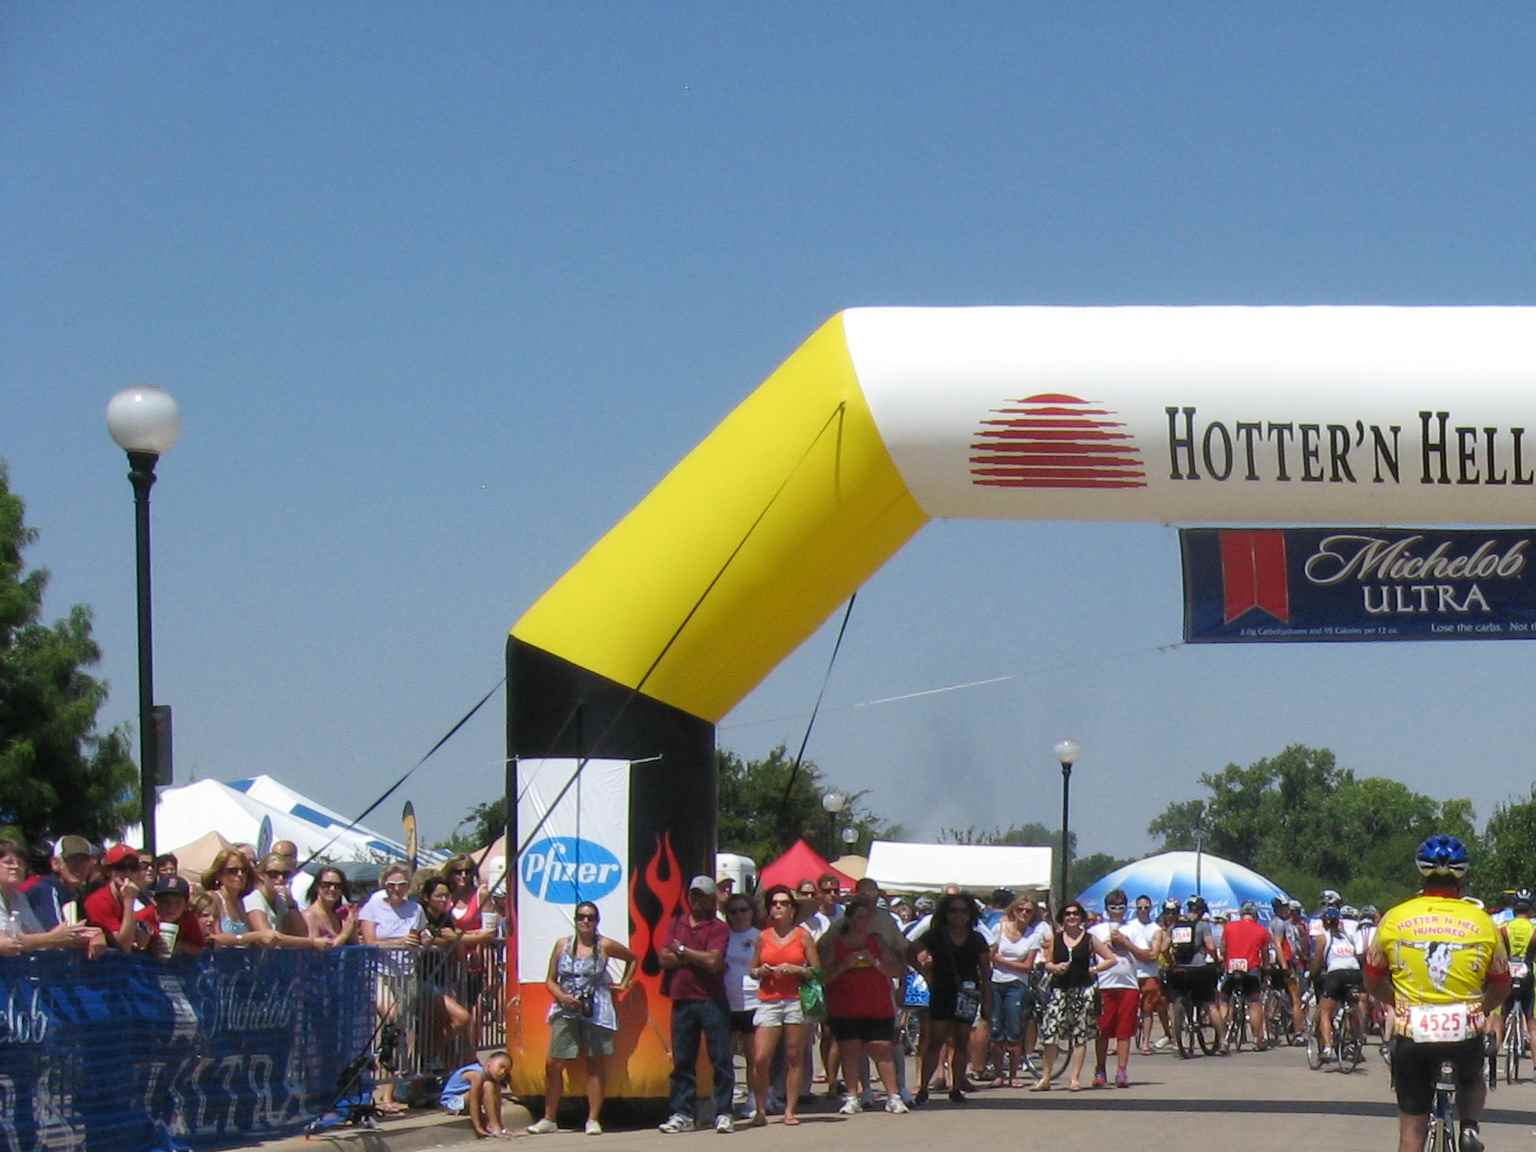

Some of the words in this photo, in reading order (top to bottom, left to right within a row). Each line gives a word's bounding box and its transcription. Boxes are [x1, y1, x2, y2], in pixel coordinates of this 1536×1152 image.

[1165, 407, 1401, 483] HOTTER'N
[1418, 411, 1534, 485] HELL
[1305, 535, 1529, 583] Michelob
[1362, 583, 1491, 613] ULTRA
[1431, 623, 1455, 632] Lose
[1457, 622, 1474, 632] the
[1509, 622, 1529, 632] Not
[525, 843, 620, 900] Pfizer
[1419, 1012, 1460, 1032] 4525
